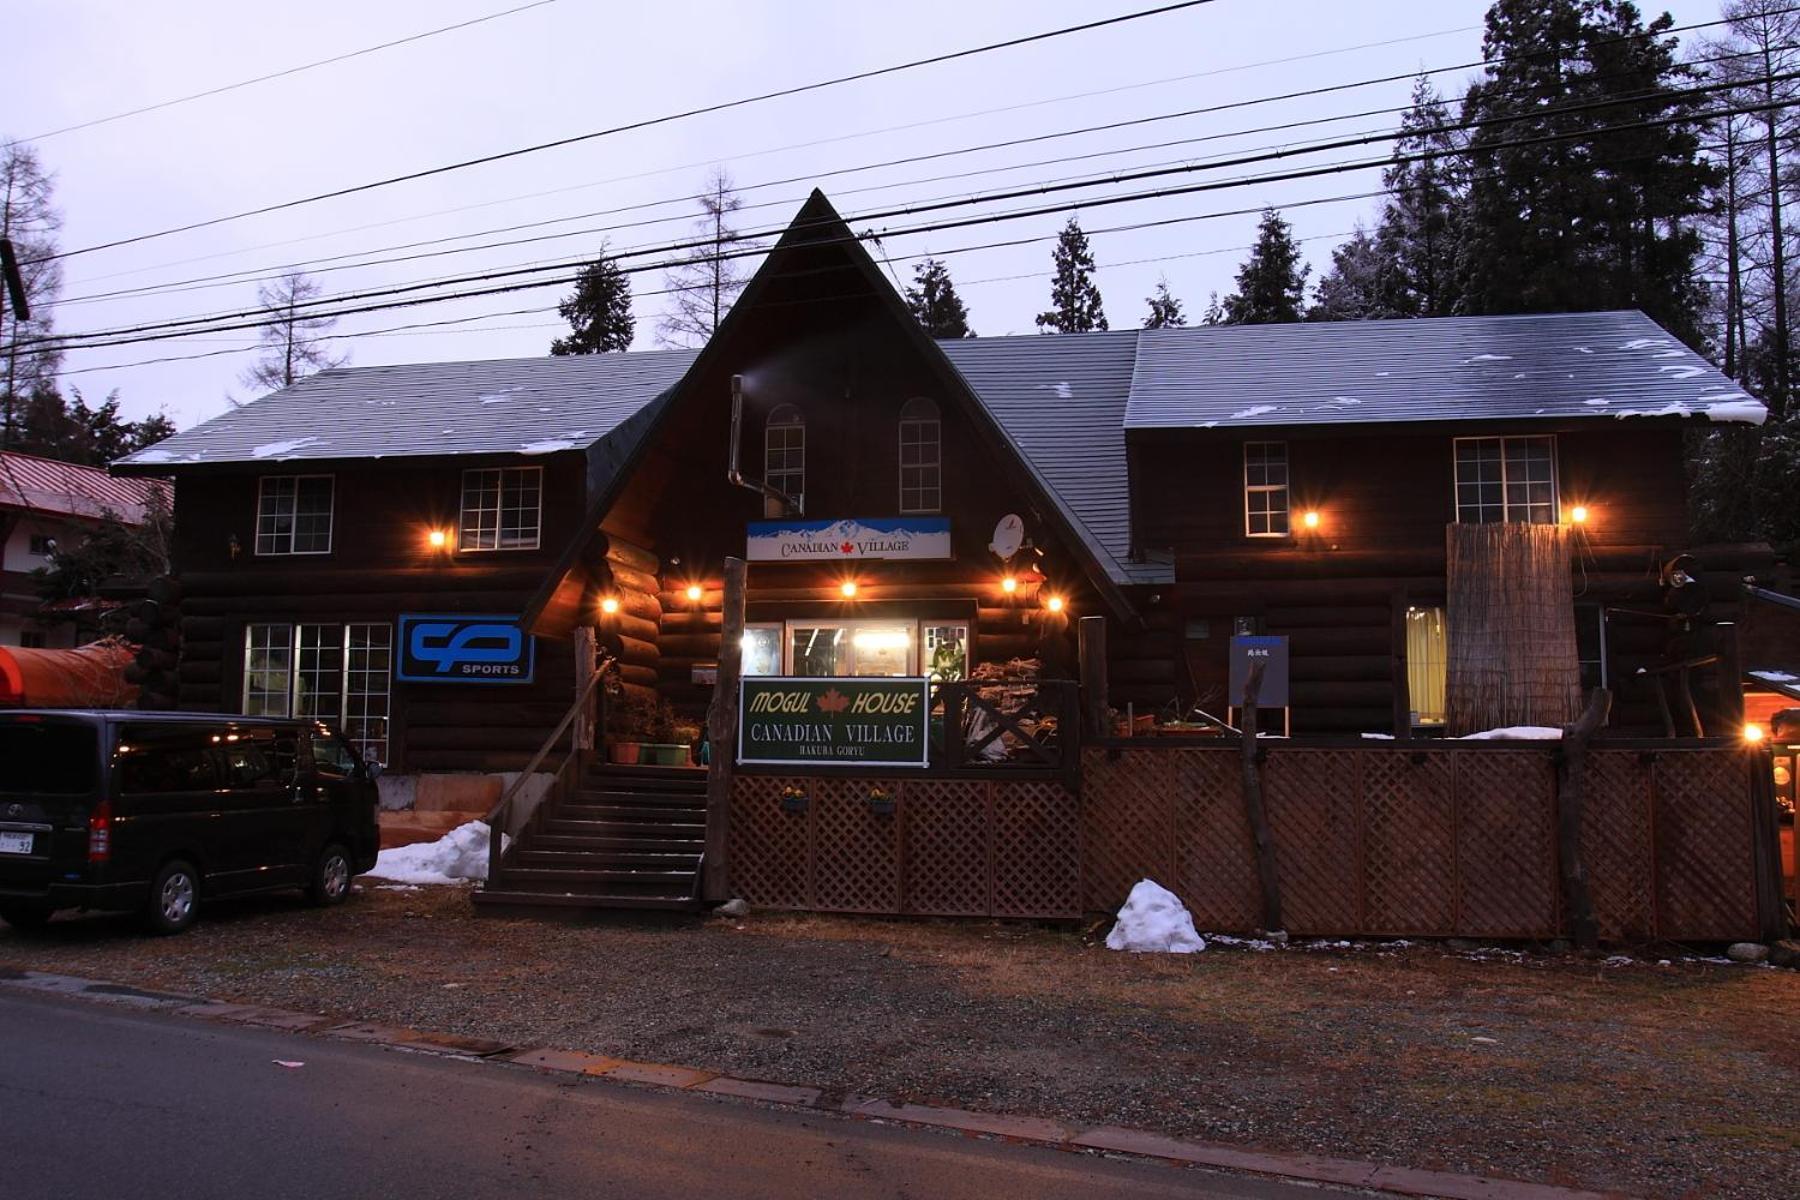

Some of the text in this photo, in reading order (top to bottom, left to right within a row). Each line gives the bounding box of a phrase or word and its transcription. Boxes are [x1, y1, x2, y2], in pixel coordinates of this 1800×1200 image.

[782, 540, 910, 558] CANADIAN VILLAGE
[463, 664, 520, 674] SPORTS
[749, 691, 921, 714] MOGUL HOUSE
[751, 723, 916, 744] CANADIAN VILLAGE
[799, 745, 835, 757] HAKUBA
